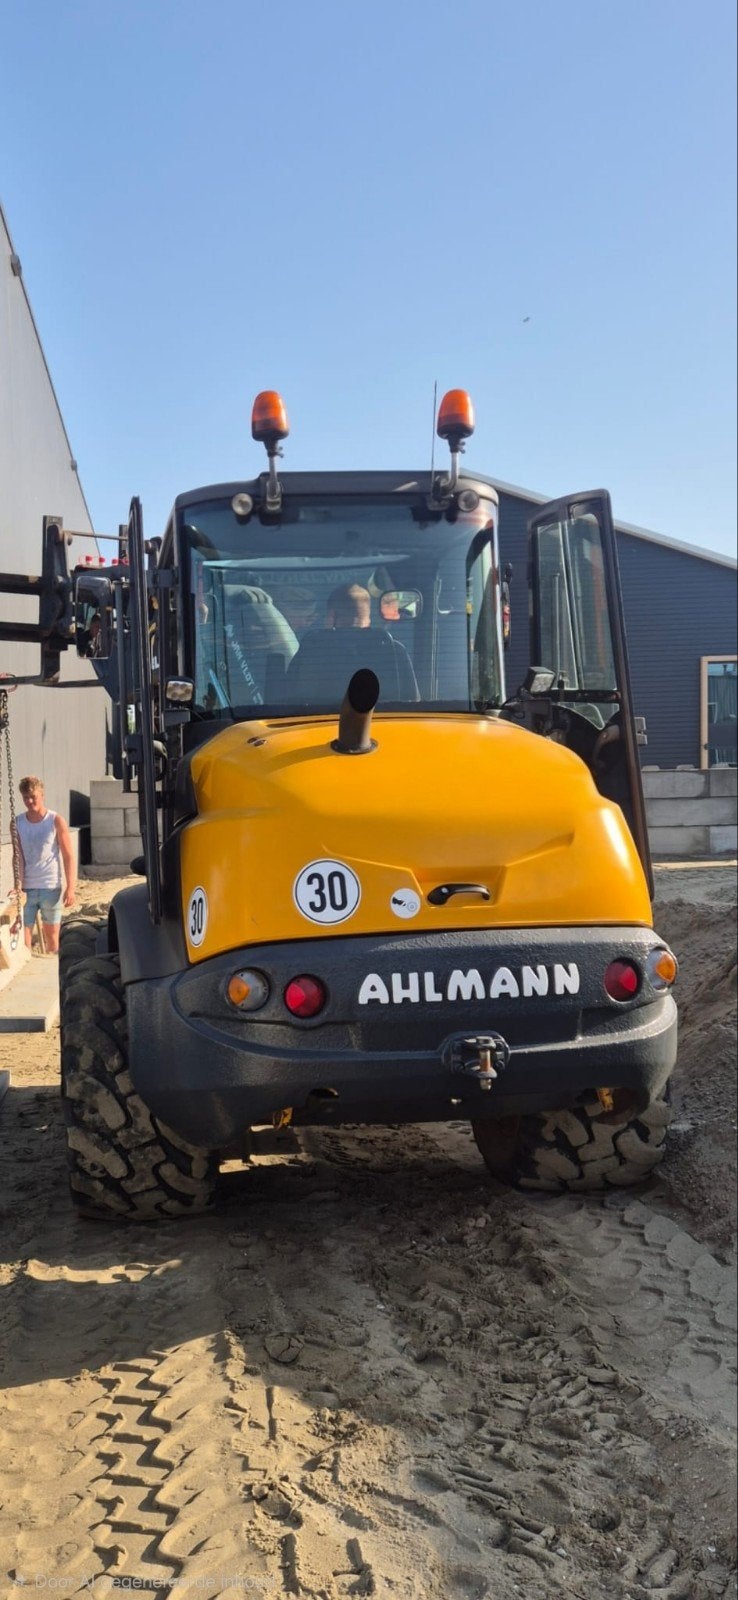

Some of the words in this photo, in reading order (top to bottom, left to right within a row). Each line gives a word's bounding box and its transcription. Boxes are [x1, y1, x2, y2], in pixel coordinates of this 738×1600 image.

[307, 870, 348, 913] 30
[191, 897, 204, 936] 30
[358, 963, 580, 1005] AHLMANN
